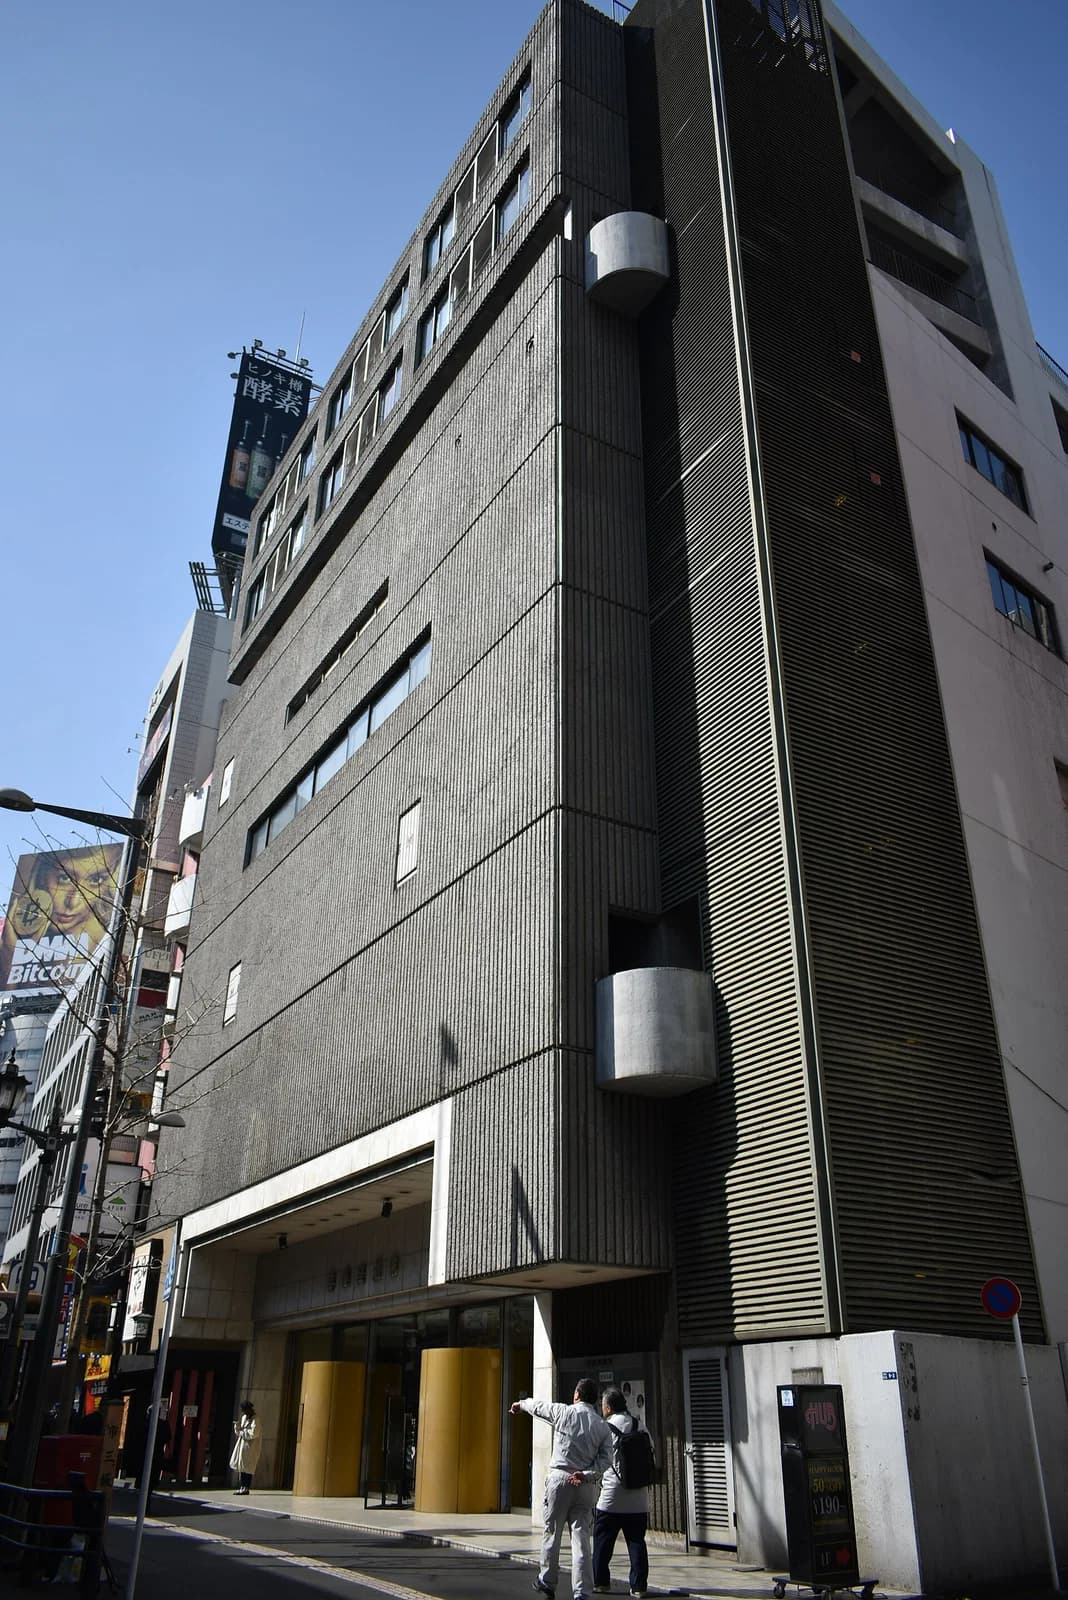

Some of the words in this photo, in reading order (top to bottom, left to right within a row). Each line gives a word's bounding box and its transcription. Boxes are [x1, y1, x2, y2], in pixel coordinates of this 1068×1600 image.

[248, 362, 304, 392] ヒノキ樽
[242, 374, 304, 417] 酵素
[11, 932, 89, 965] DMM
[7, 962, 85, 985] Bitcoin
